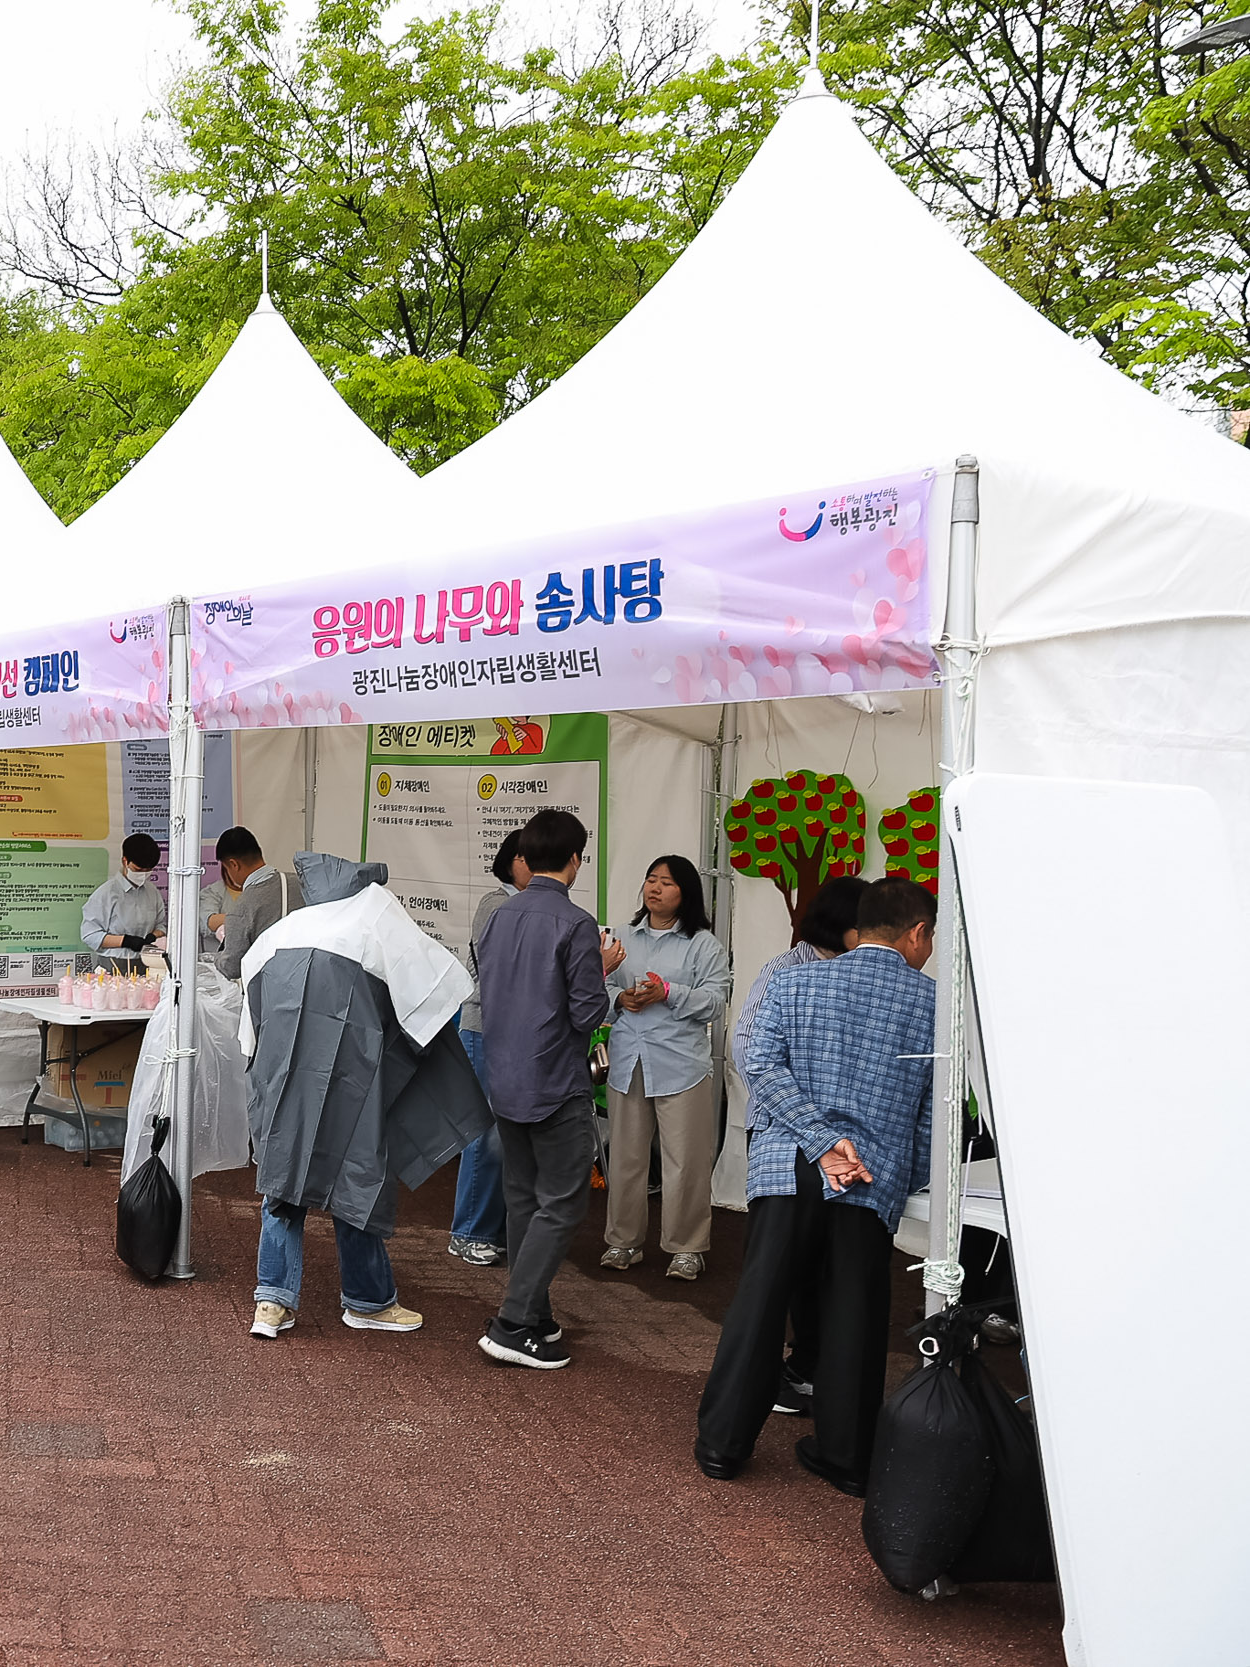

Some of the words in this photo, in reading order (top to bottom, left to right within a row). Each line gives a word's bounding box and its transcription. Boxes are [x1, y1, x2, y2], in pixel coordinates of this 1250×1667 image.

[830, 503, 898, 535] 행복광진
[312, 596, 405, 658] 응원의
[413, 579, 524, 644] 나무와
[535, 558, 665, 633] 솜사탕
[23, 650, 79, 697] 캠페인
[352, 647, 602, 696] 광진나눔장애인자립생활센터
[378, 725, 422, 748] 장애인
[426, 724, 476, 748] 에티켓
[380, 780, 389, 790] 01
[394, 780, 431, 793] 지체장애인
[481, 782, 493, 793] 02
[500, 780, 548, 794] 시각장애인
[409, 896, 448, 911] 언어장애인
